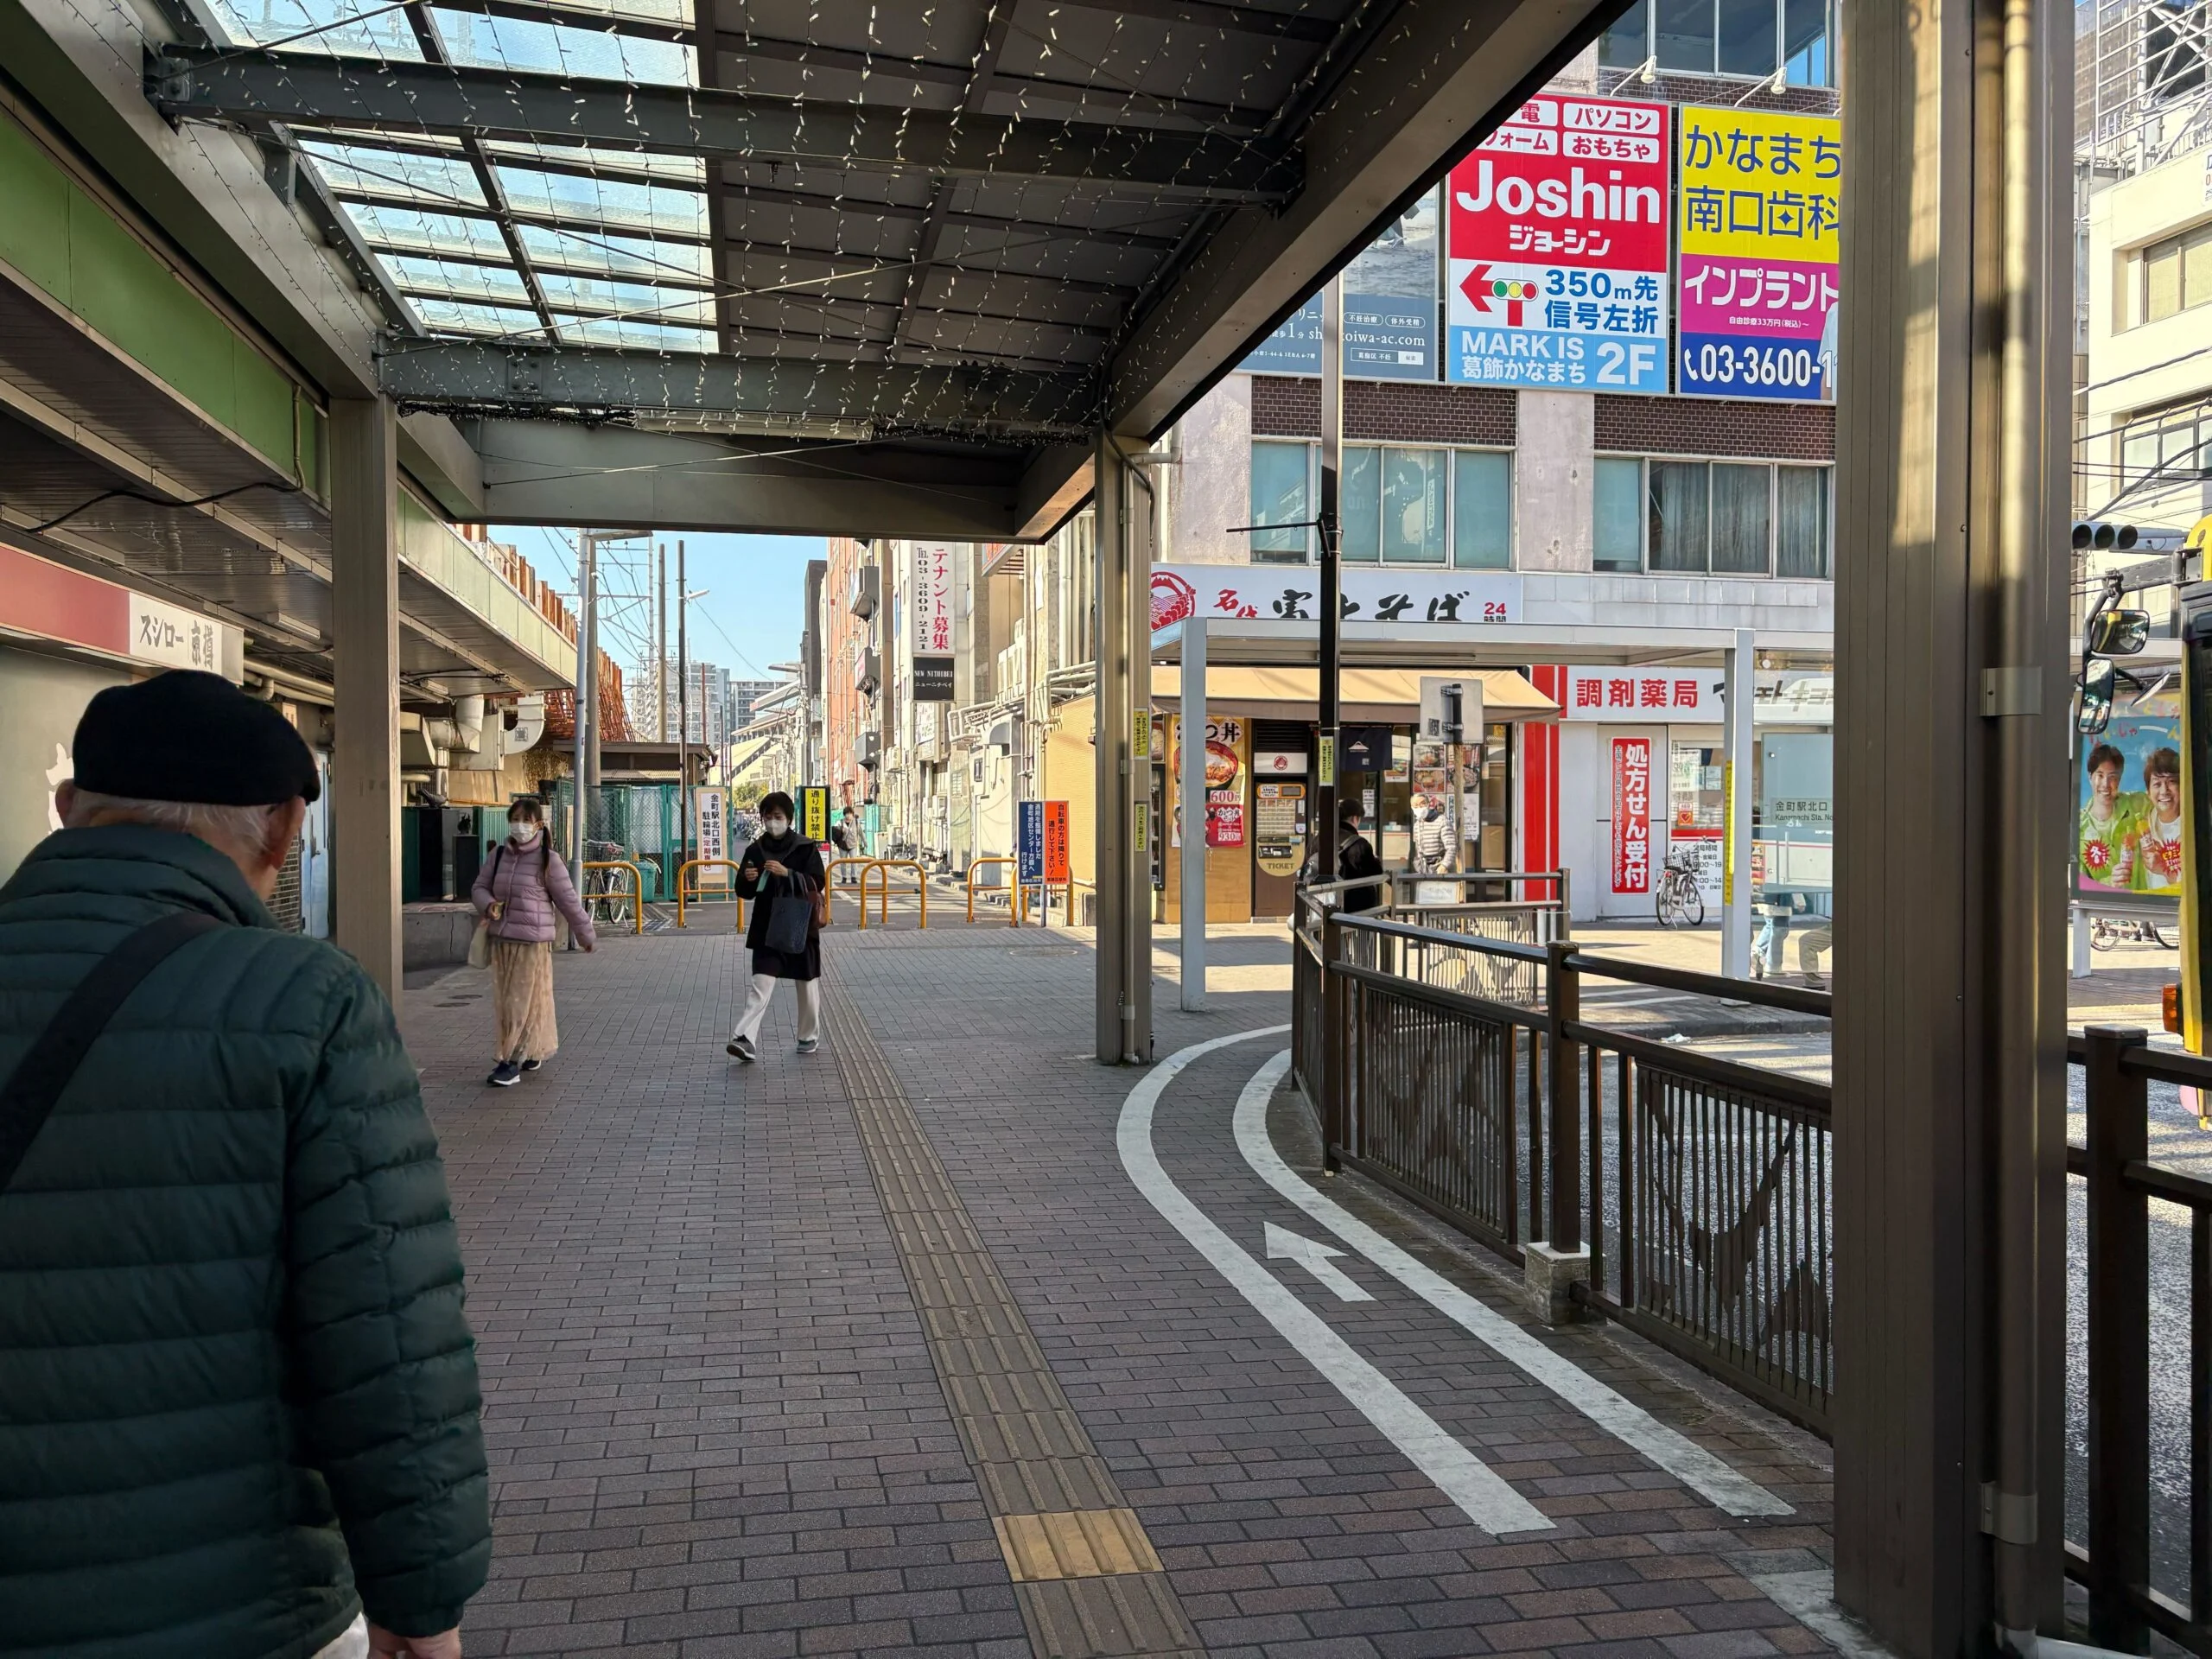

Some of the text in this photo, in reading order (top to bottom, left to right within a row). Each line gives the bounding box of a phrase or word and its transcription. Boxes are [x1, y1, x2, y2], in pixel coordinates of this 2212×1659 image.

[1573, 105, 1651, 130] パソコン
[1572, 136, 1650, 159] おもちゃ
[1685, 124, 1840, 180] かなまち
[1456, 160, 1660, 224] Joshin
[1686, 185, 1840, 241] 南口歯科
[1510, 225, 1611, 256] ジョーシン
[1545, 270, 1658, 302] 350m先
[1684, 264, 1839, 312] インプラント
[1349, 315, 1377, 324] 不妊治療
[1544, 299, 1658, 335] 信号左折
[1462, 333, 1584, 360] MARK IS
[1597, 343, 1657, 385] 2F
[1462, 356, 1586, 384] 葛飾かなまち
[1700, 343, 1839, 389] 03-3600-1
[918, 559, 929, 651] 03-3609-2121
[932, 548, 949, 651] テナント募集
[1484, 601, 1507, 615] 24
[139, 614, 185, 648] スシロー
[1576, 678, 1699, 709] 調剤薬局
[1176, 721, 1241, 743] つ丼
[810, 789, 821, 840] 通り抜け禁止
[1624, 744, 1649, 889] 処方せん受付
[1775, 801, 1827, 811] 金町駅北口
[710, 793, 721, 856] 金町駅北口西側
